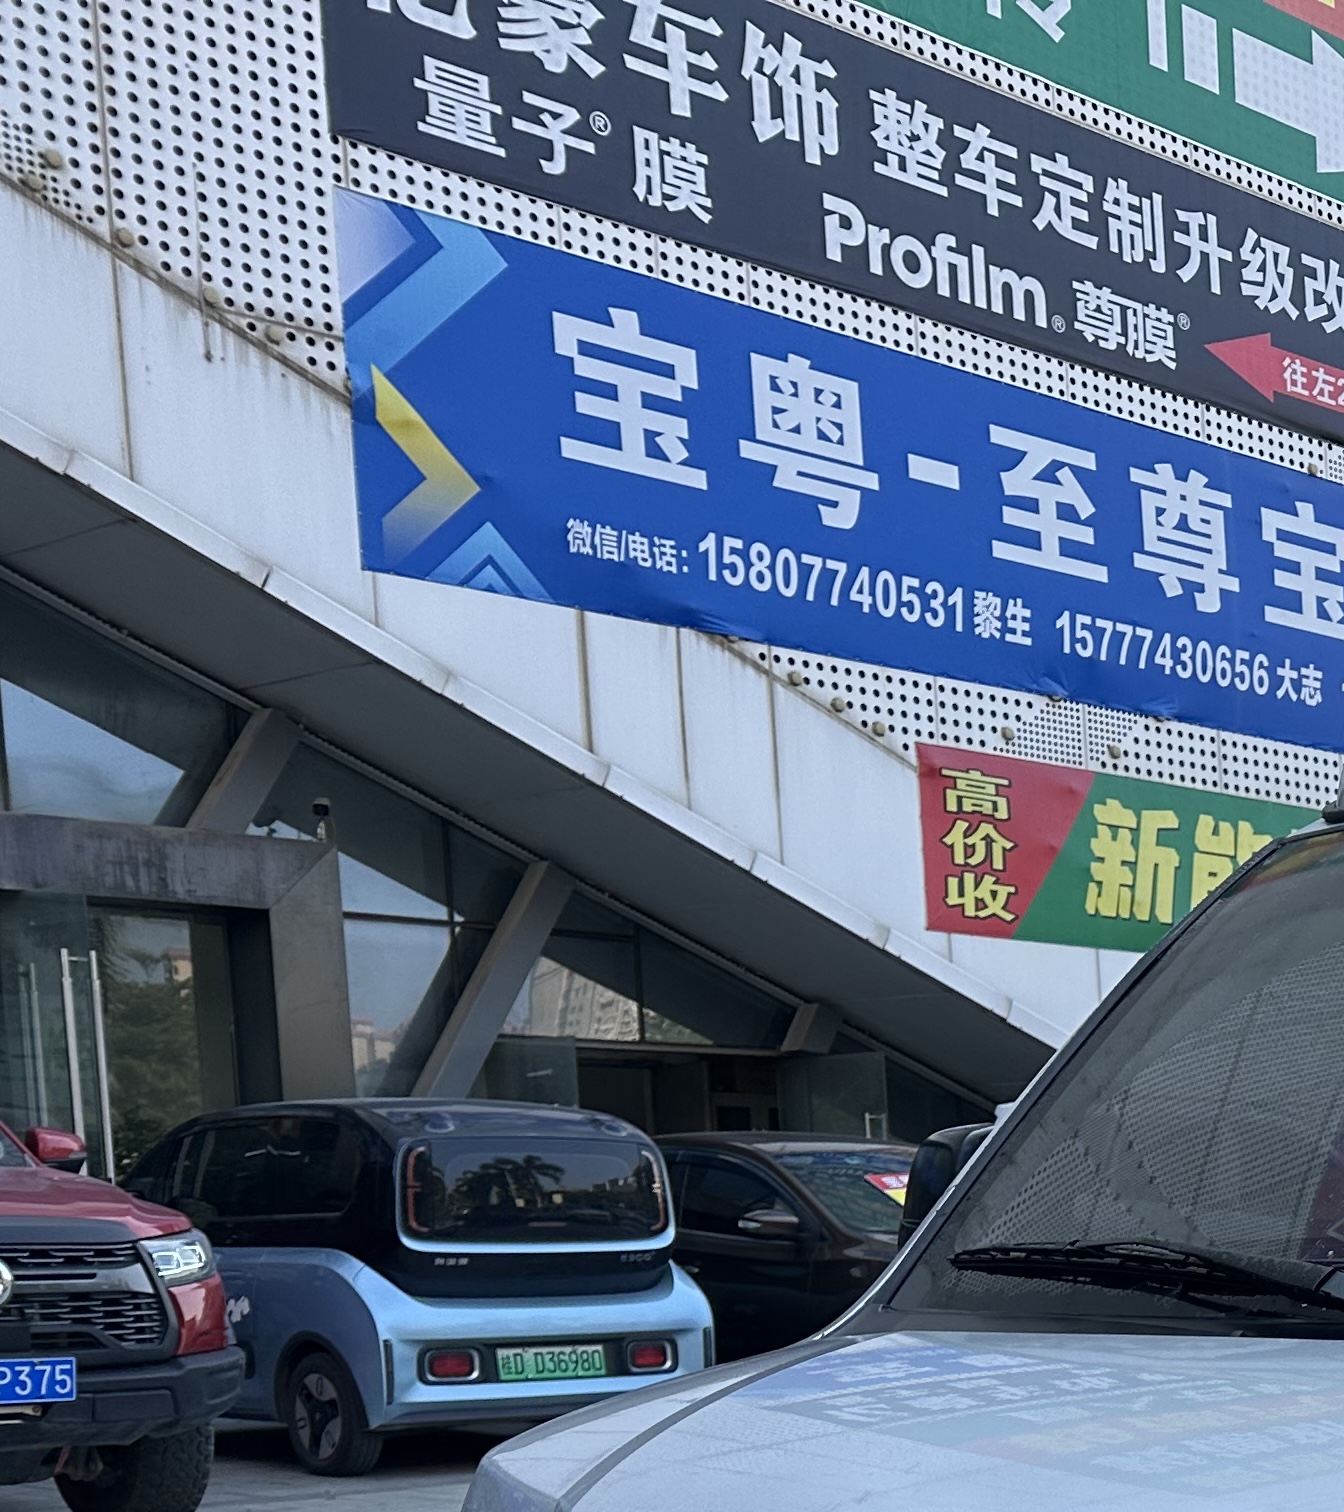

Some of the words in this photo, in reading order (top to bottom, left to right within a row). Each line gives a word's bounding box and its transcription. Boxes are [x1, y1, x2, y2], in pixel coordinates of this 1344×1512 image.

[697, 531, 964, 633] 15807740531
[1056, 609, 1269, 696] 15777430656
[938, 769, 1018, 923] 高价收
